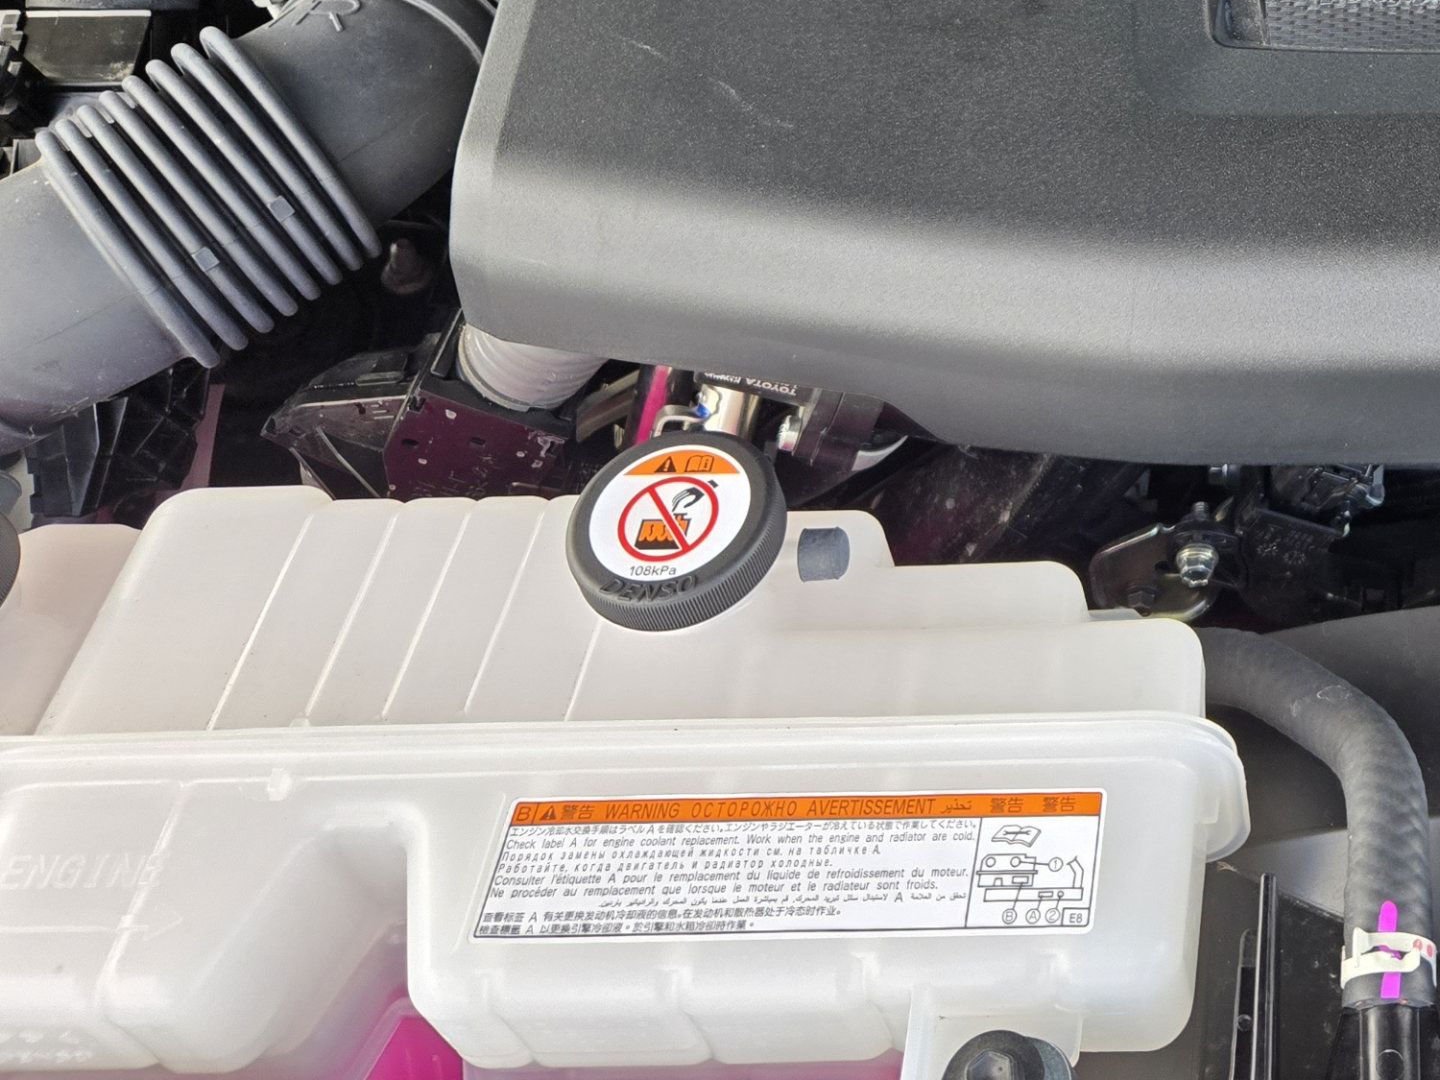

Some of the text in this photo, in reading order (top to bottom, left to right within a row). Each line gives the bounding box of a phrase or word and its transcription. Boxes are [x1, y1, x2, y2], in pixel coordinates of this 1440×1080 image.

[745, 377, 798, 397] TOYOTA
[628, 565, 677, 577] 108kPa
[600, 574, 698, 604] DENSO
[517, 806, 532, 820] B
[562, 804, 595, 820] 警告
[604, 802, 681, 819] WARNING
[691, 800, 797, 819] ОСТОРОЖНО
[806, 798, 936, 817] AVERTISSEMENT
[940, 799, 972, 814] تحذير
[990, 797, 1024, 814] 警告
[1043, 796, 1076, 813] 警告
[506, 831, 975, 850] Check label A for engine coolant replacement. Work when the engine and radiator are cold.
[501, 851, 554, 863] Порядок
[560, 850, 606, 861] замены
[611, 847, 694, 860] охлаждающей
[699, 846, 760, 858] жидкости
[788, 846, 802, 856] на
[809, 844, 868, 856] табличке
[1, 852, 164, 890] ENGINE
[497, 858, 833, 874] Работайте, когда двигатель и радиатор холодные.
[493, 874, 545, 886] Consulter
[607, 872, 617, 884] A
[622, 873, 648, 885] pour
[653, 872, 663, 883] le
[669, 871, 740, 884] remplacement
[746, 870, 761, 881] du
[766, 869, 801, 882] liquide
[807, 869, 820, 880] de
[825, 867, 905, 879] refroidissement
[910, 866, 925, 877] du
[931, 867, 969, 878] moteur.
[489, 878, 938, 899] Ne procéder au remplacement que lorsque le moteur et le radiateur sont froids.
[1068, 913, 1083, 924] E8
